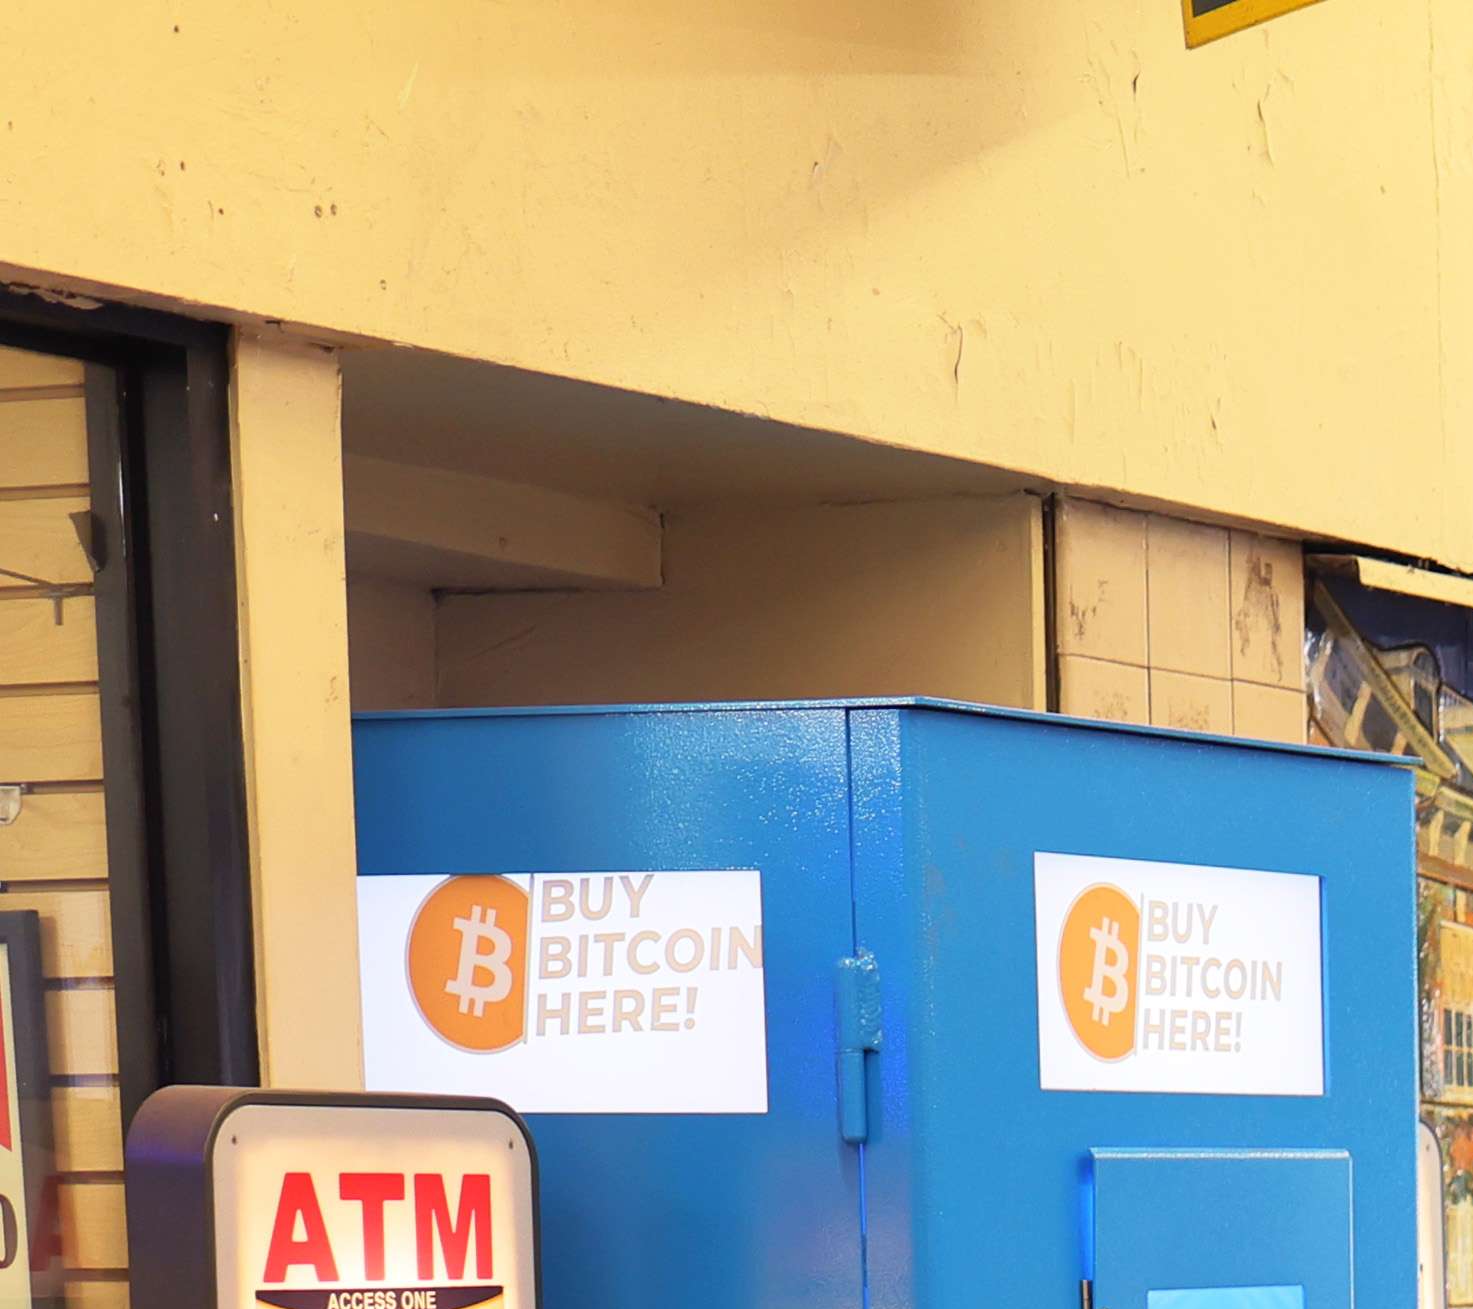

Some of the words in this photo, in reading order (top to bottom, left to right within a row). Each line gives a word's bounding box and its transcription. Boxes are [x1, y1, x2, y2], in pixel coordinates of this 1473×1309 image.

[540, 873, 655, 923] BUY
[1147, 899, 1219, 945] BUY
[538, 925, 763, 980] BITCOIN
[1145, 954, 1283, 1002] BITCOIN
[535, 986, 698, 1037] HERE!
[1142, 1008, 1243, 1053] HERE!
[263, 1172, 493, 1283] ATM
[401, 1290, 438, 1309] ONE
